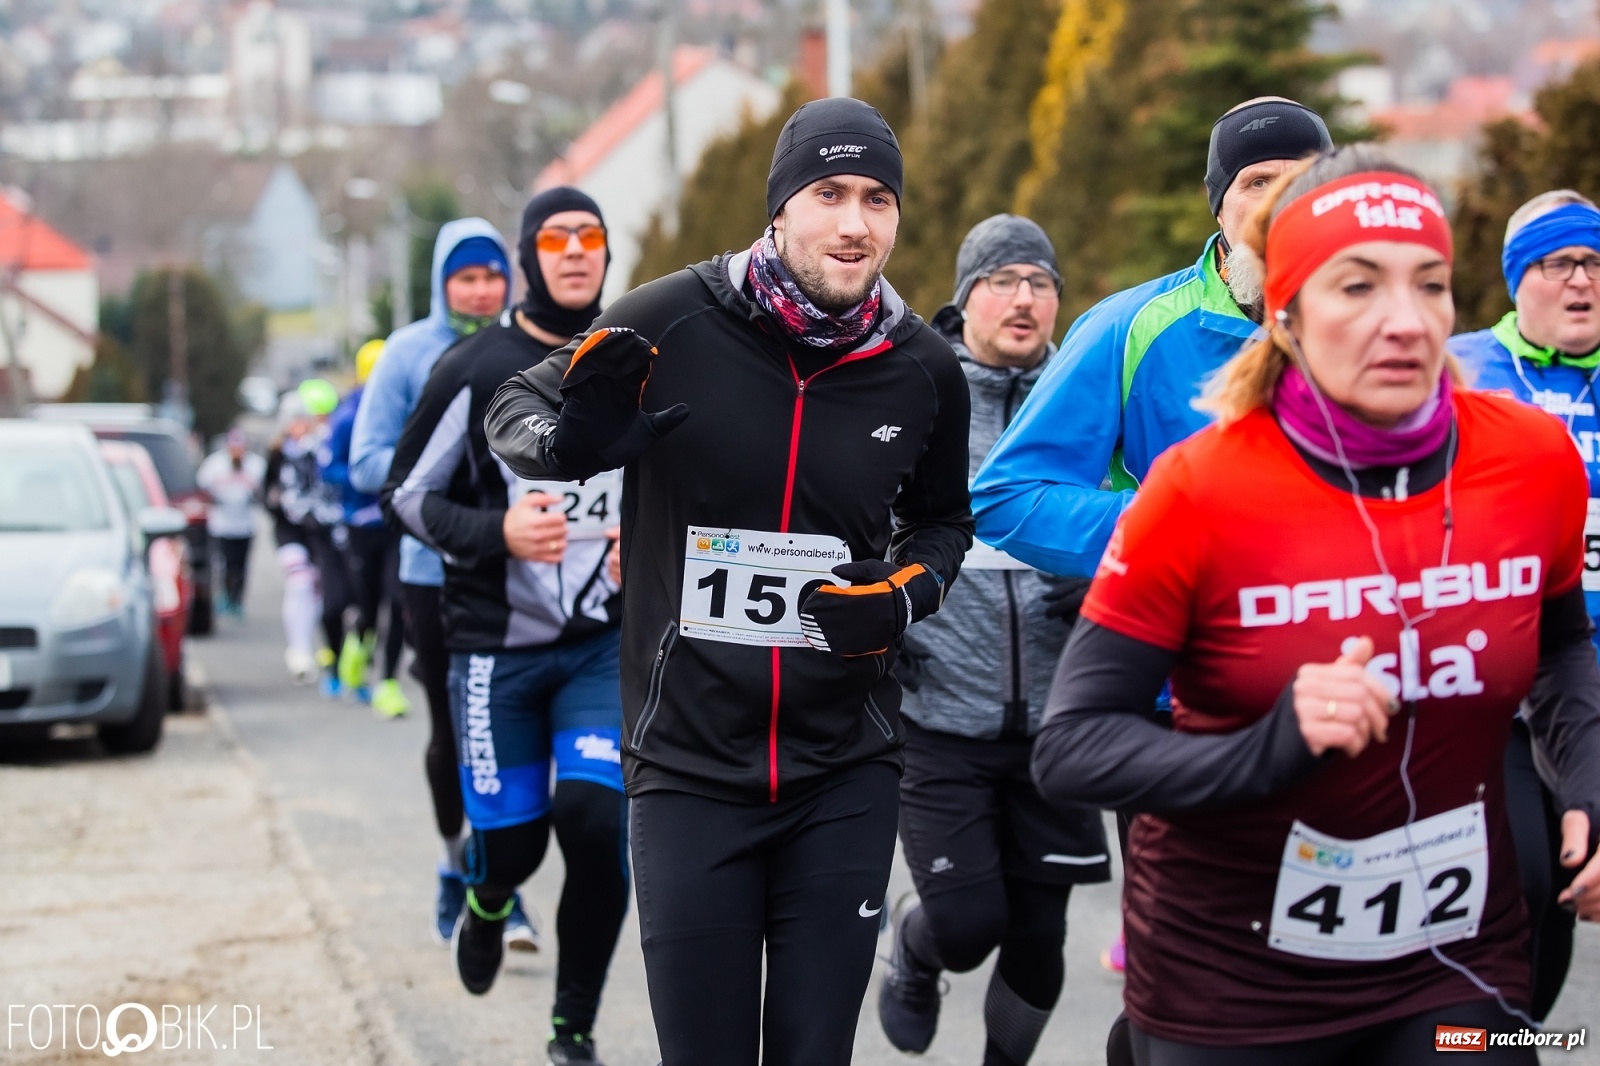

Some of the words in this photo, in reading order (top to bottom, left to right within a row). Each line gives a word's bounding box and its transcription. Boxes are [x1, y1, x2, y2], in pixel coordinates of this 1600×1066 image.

[1238, 116, 1281, 133] 4F
[871, 424, 902, 442] 4F
[527, 489, 609, 522] 24
[748, 543, 846, 561] www.personalbest.pl
[1238, 555, 1542, 628] DAR-BUD
[467, 653, 502, 796] RUNNERS
[1286, 866, 1473, 936] 412
